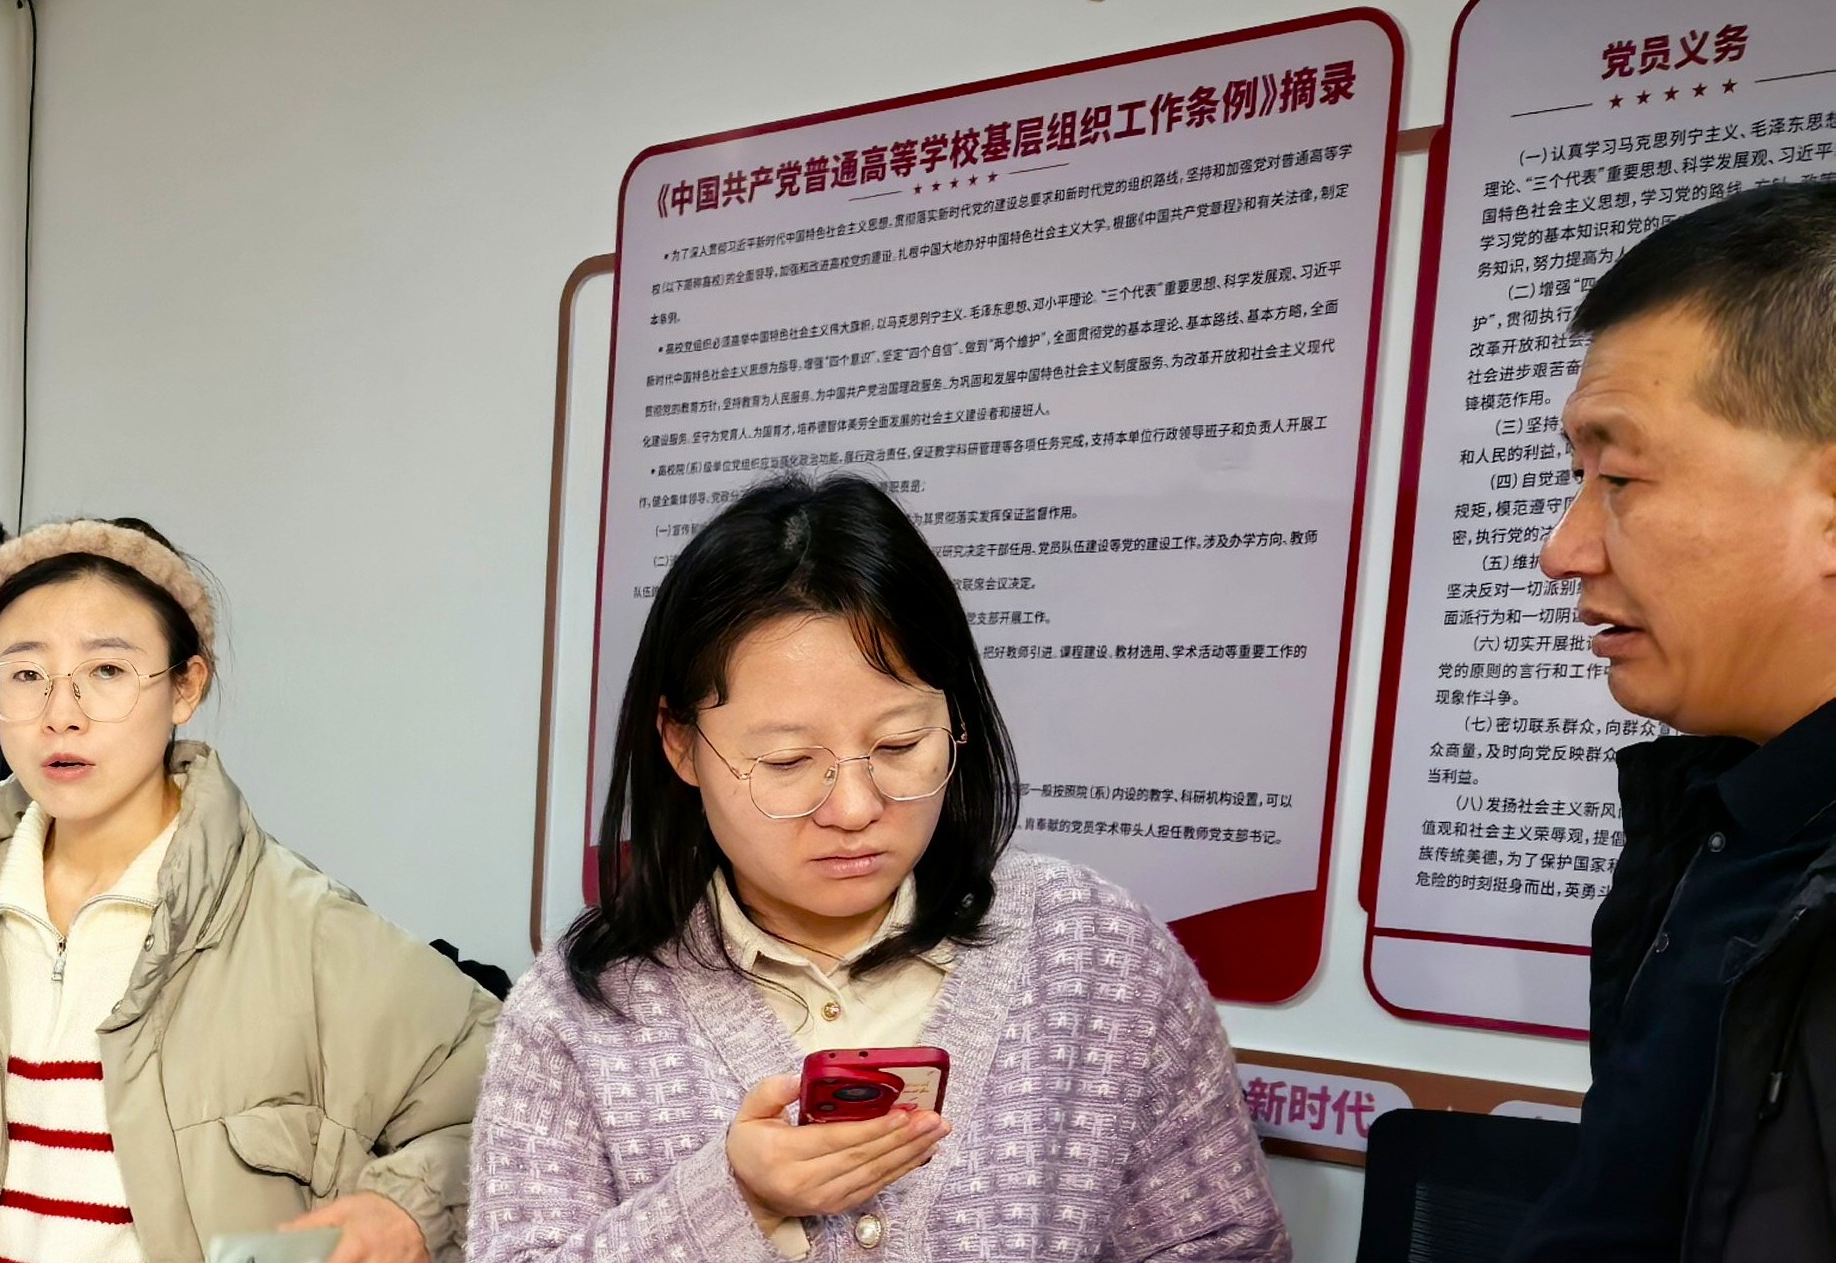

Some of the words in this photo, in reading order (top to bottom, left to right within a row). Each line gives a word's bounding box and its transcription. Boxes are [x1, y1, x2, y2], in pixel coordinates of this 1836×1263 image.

[1601, 24, 1749, 81] 党员义务
[657, 59, 1357, 218] 《中国共产党普通高等学校基层组织工作条例》摘录
[1465, 390, 1551, 412] 锋模范作用。
[1435, 689, 1519, 706] 现象作斗争。
[1427, 768, 1479, 786] 当利益。
[1246, 1076, 1376, 1140] 新时代
